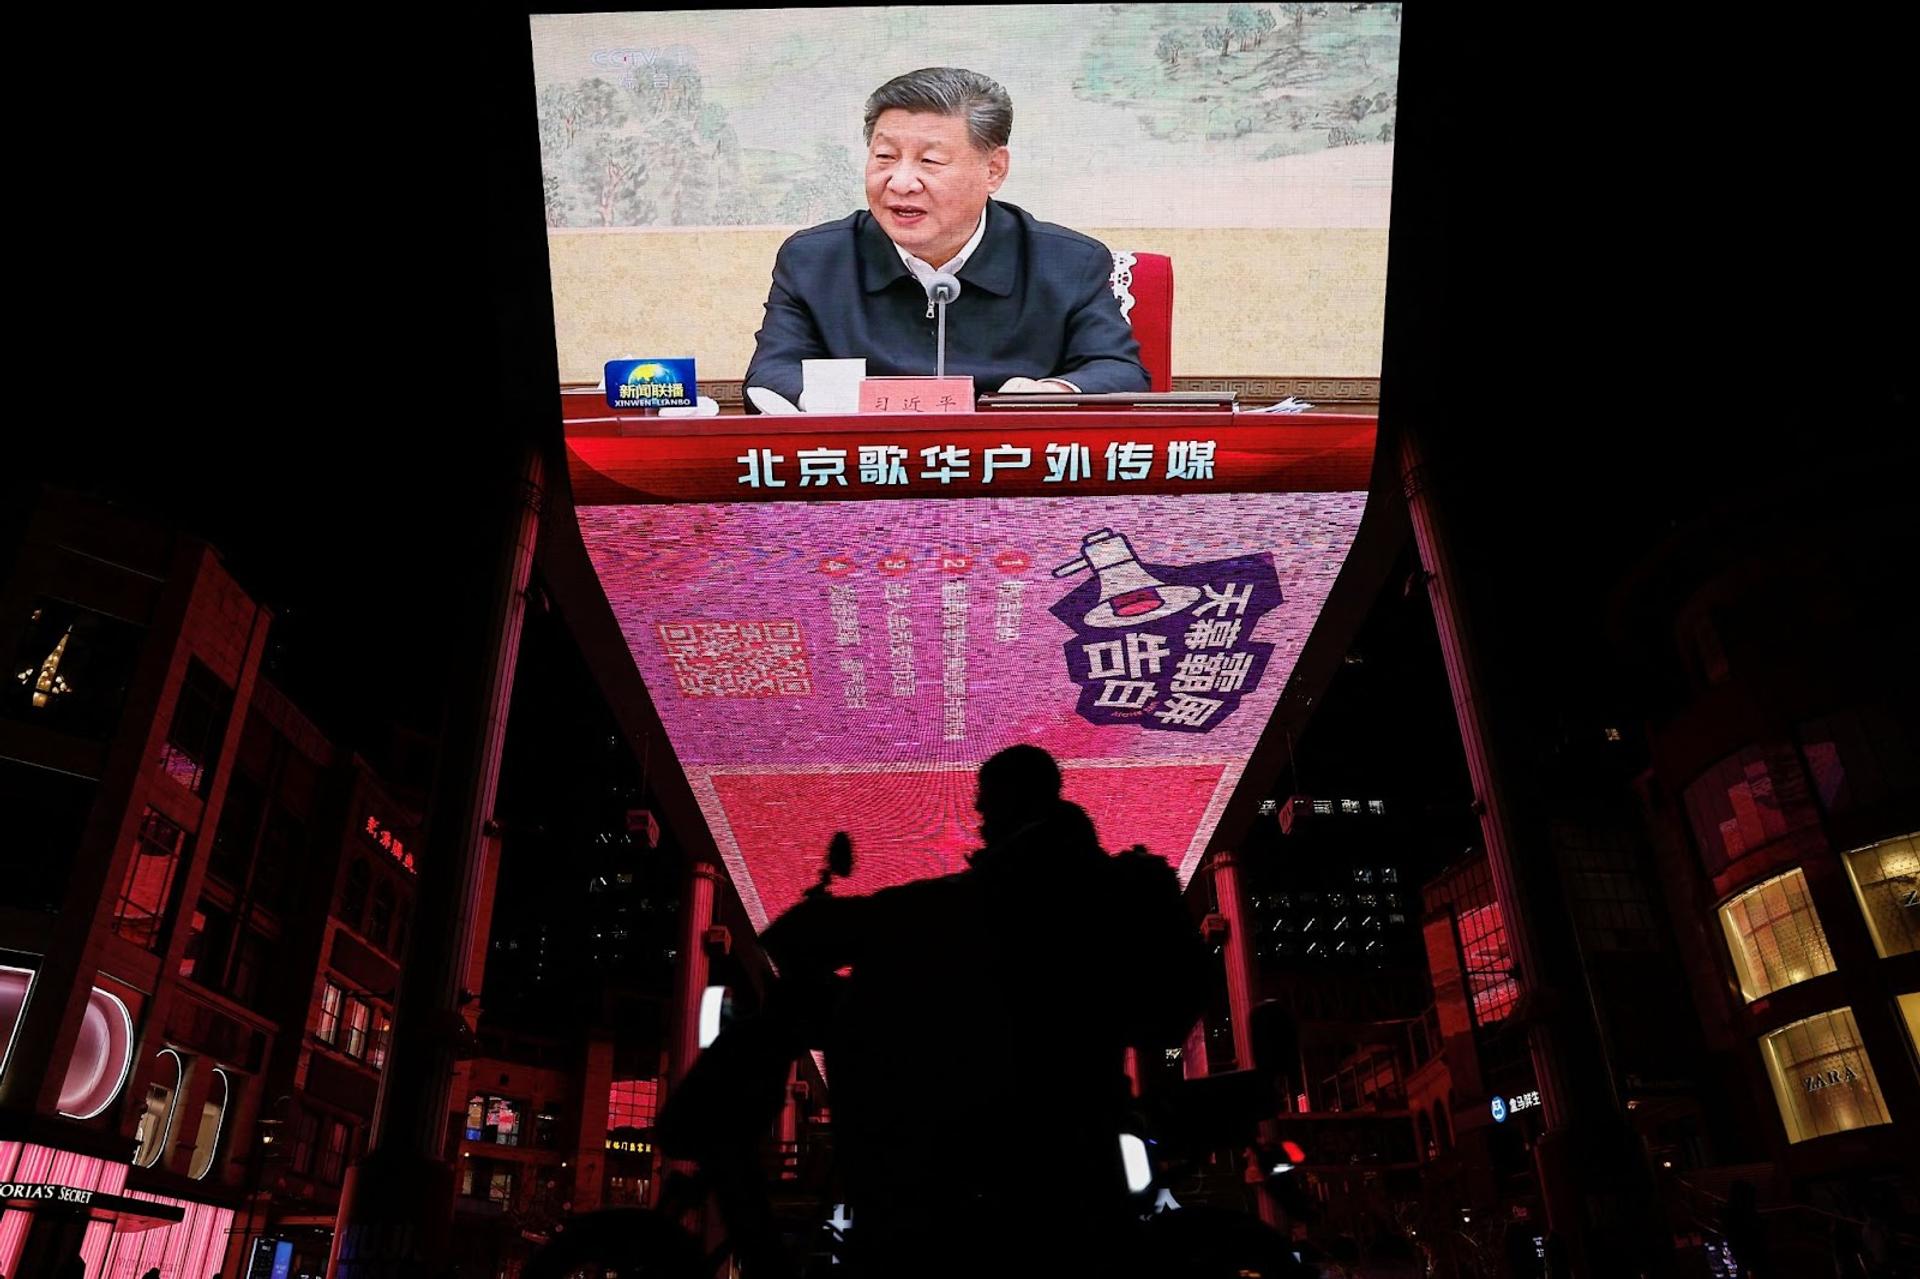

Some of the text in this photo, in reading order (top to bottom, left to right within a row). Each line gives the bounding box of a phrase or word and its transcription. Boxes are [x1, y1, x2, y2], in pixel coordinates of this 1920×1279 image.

[619, 383, 684, 399] 新闻联播
[614, 398, 691, 408] XINWEN LIANBO
[875, 395, 957, 413] 习近平
[737, 440, 1217, 488] 北京歌华户外传媒
[827, 560, 849, 571] 4
[885, 559, 907, 570] 3
[943, 558, 966, 569] 2
[1154, 582, 1255, 727] 天幕霸屏
[1082, 632, 1171, 710] 告白
[1803, 1065, 1858, 1093] ZARA
[0, 1183, 93, 1204] ORIA'S SECRET
